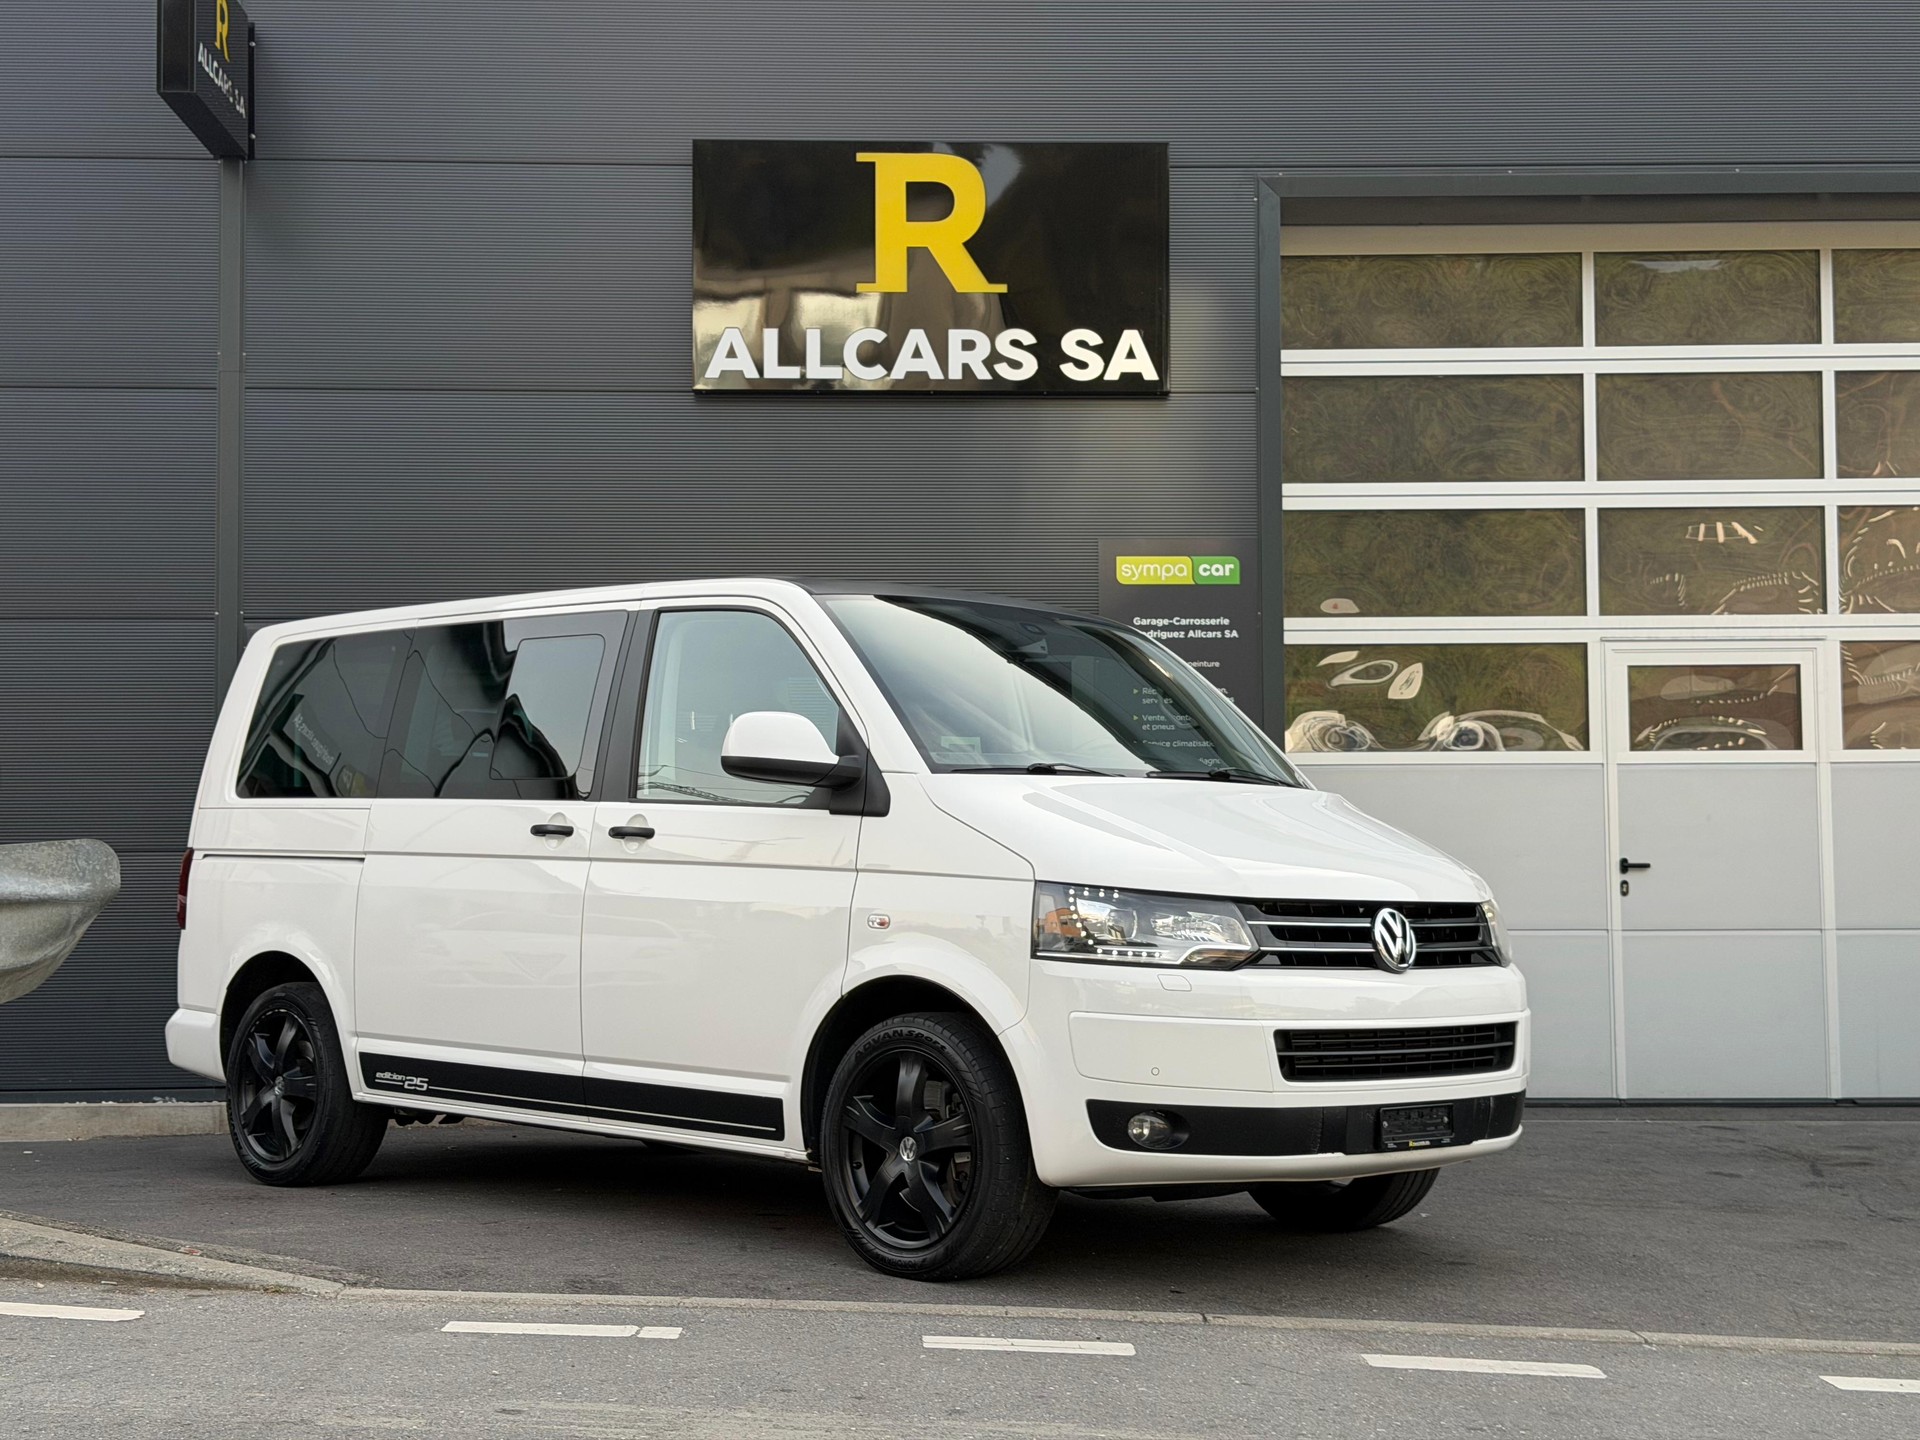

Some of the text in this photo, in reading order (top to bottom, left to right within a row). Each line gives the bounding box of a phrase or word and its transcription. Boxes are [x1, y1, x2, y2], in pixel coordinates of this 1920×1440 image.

[856, 152, 1008, 293] R
[704, 327, 1159, 381] ALLCARS SA
[1121, 562, 1235, 580] sympa car
[1133, 617, 1230, 627] Garage-Carrosserie
[1145, 629, 1238, 640] driguez Allcars SA
[905, 1029, 948, 1052] Sport
[375, 1071, 428, 1091] edition 25
